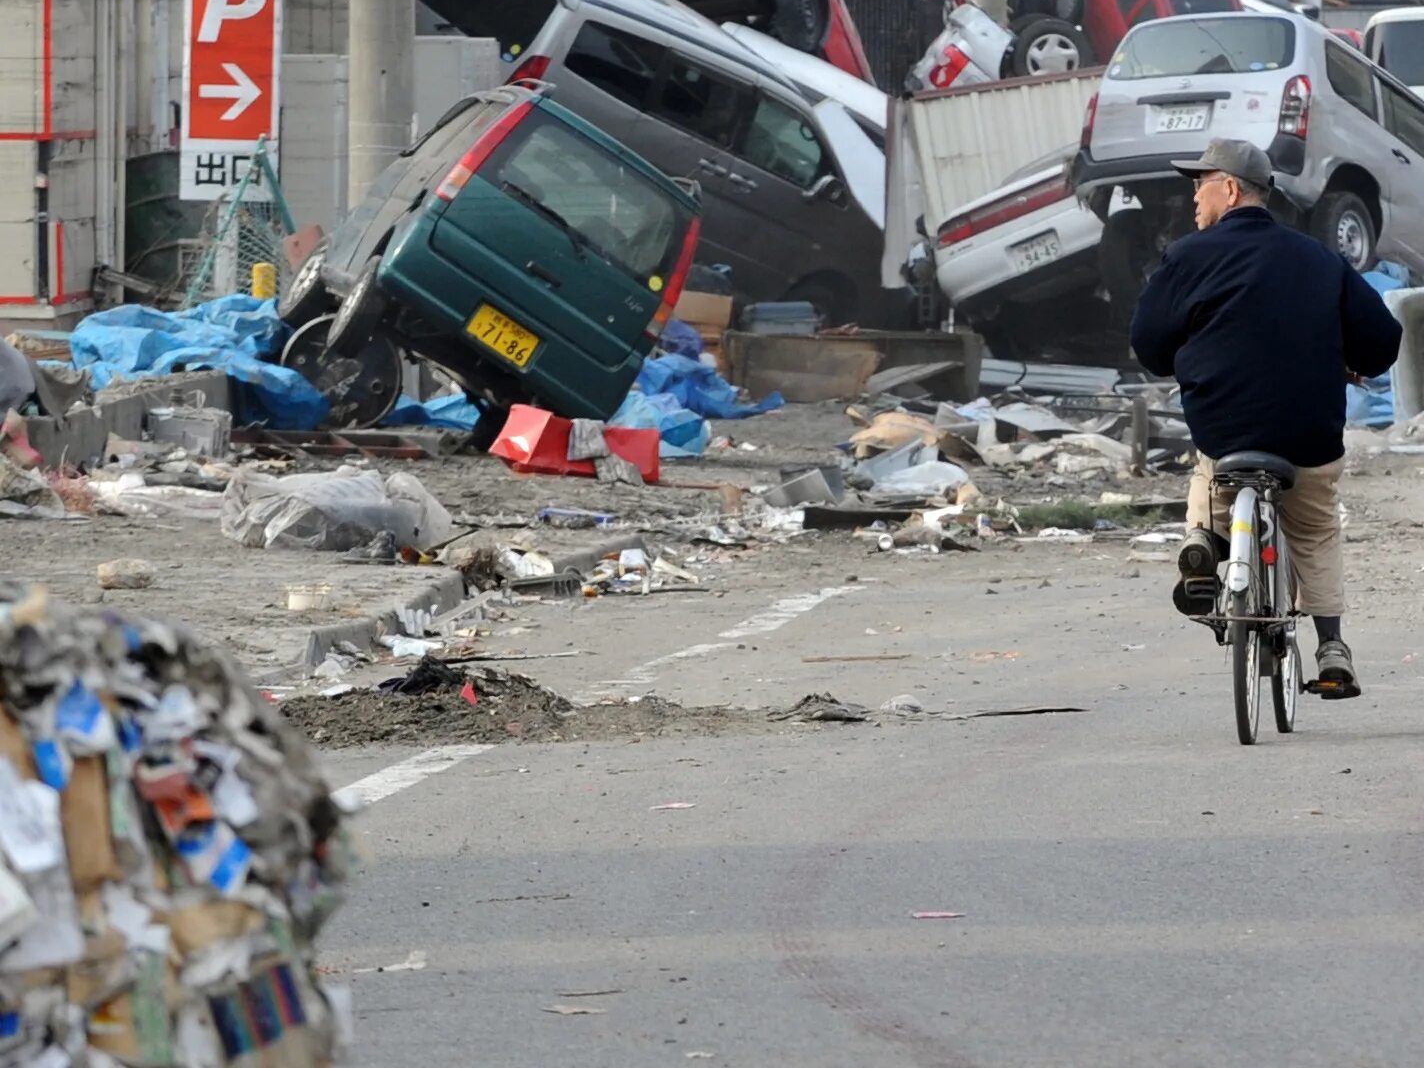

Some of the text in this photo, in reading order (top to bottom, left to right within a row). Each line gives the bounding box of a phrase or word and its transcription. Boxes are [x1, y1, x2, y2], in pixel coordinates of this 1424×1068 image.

[1166, 115, 1203, 130] 87-17
[195, 152, 261, 187] 出口
[481, 323, 528, 362] 71-86
